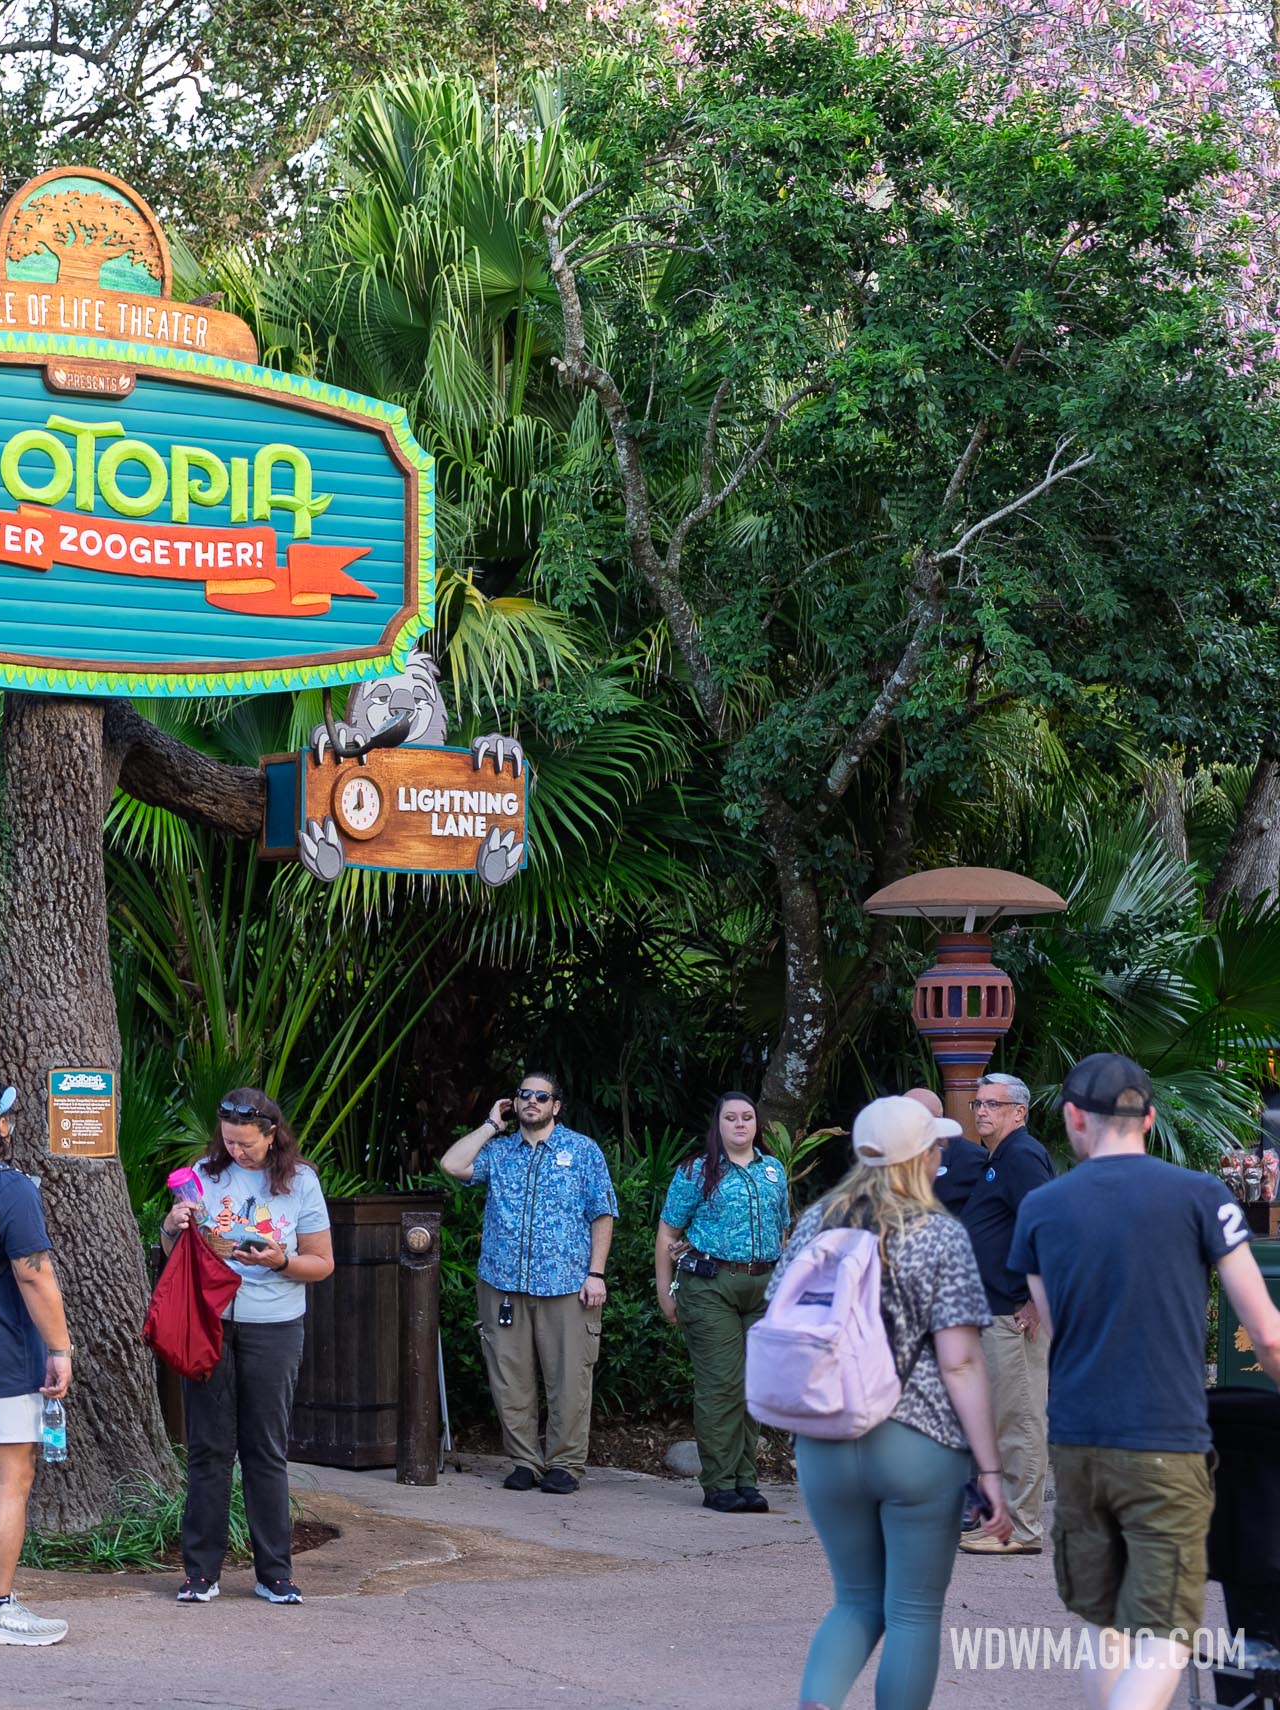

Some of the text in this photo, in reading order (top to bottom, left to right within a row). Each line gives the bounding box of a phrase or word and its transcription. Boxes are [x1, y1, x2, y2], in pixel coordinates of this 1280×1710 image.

[28, 293, 51, 328] OF
[59, 296, 106, 333] LIFE
[118, 301, 209, 348] THEATER
[67, 373, 117, 392] PRESENTS
[59, 530, 265, 569] ZOOGETHER!
[397, 787, 519, 816] LIGHTNING
[431, 813, 487, 838] LANE
[1216, 1202, 1249, 1247] 2
